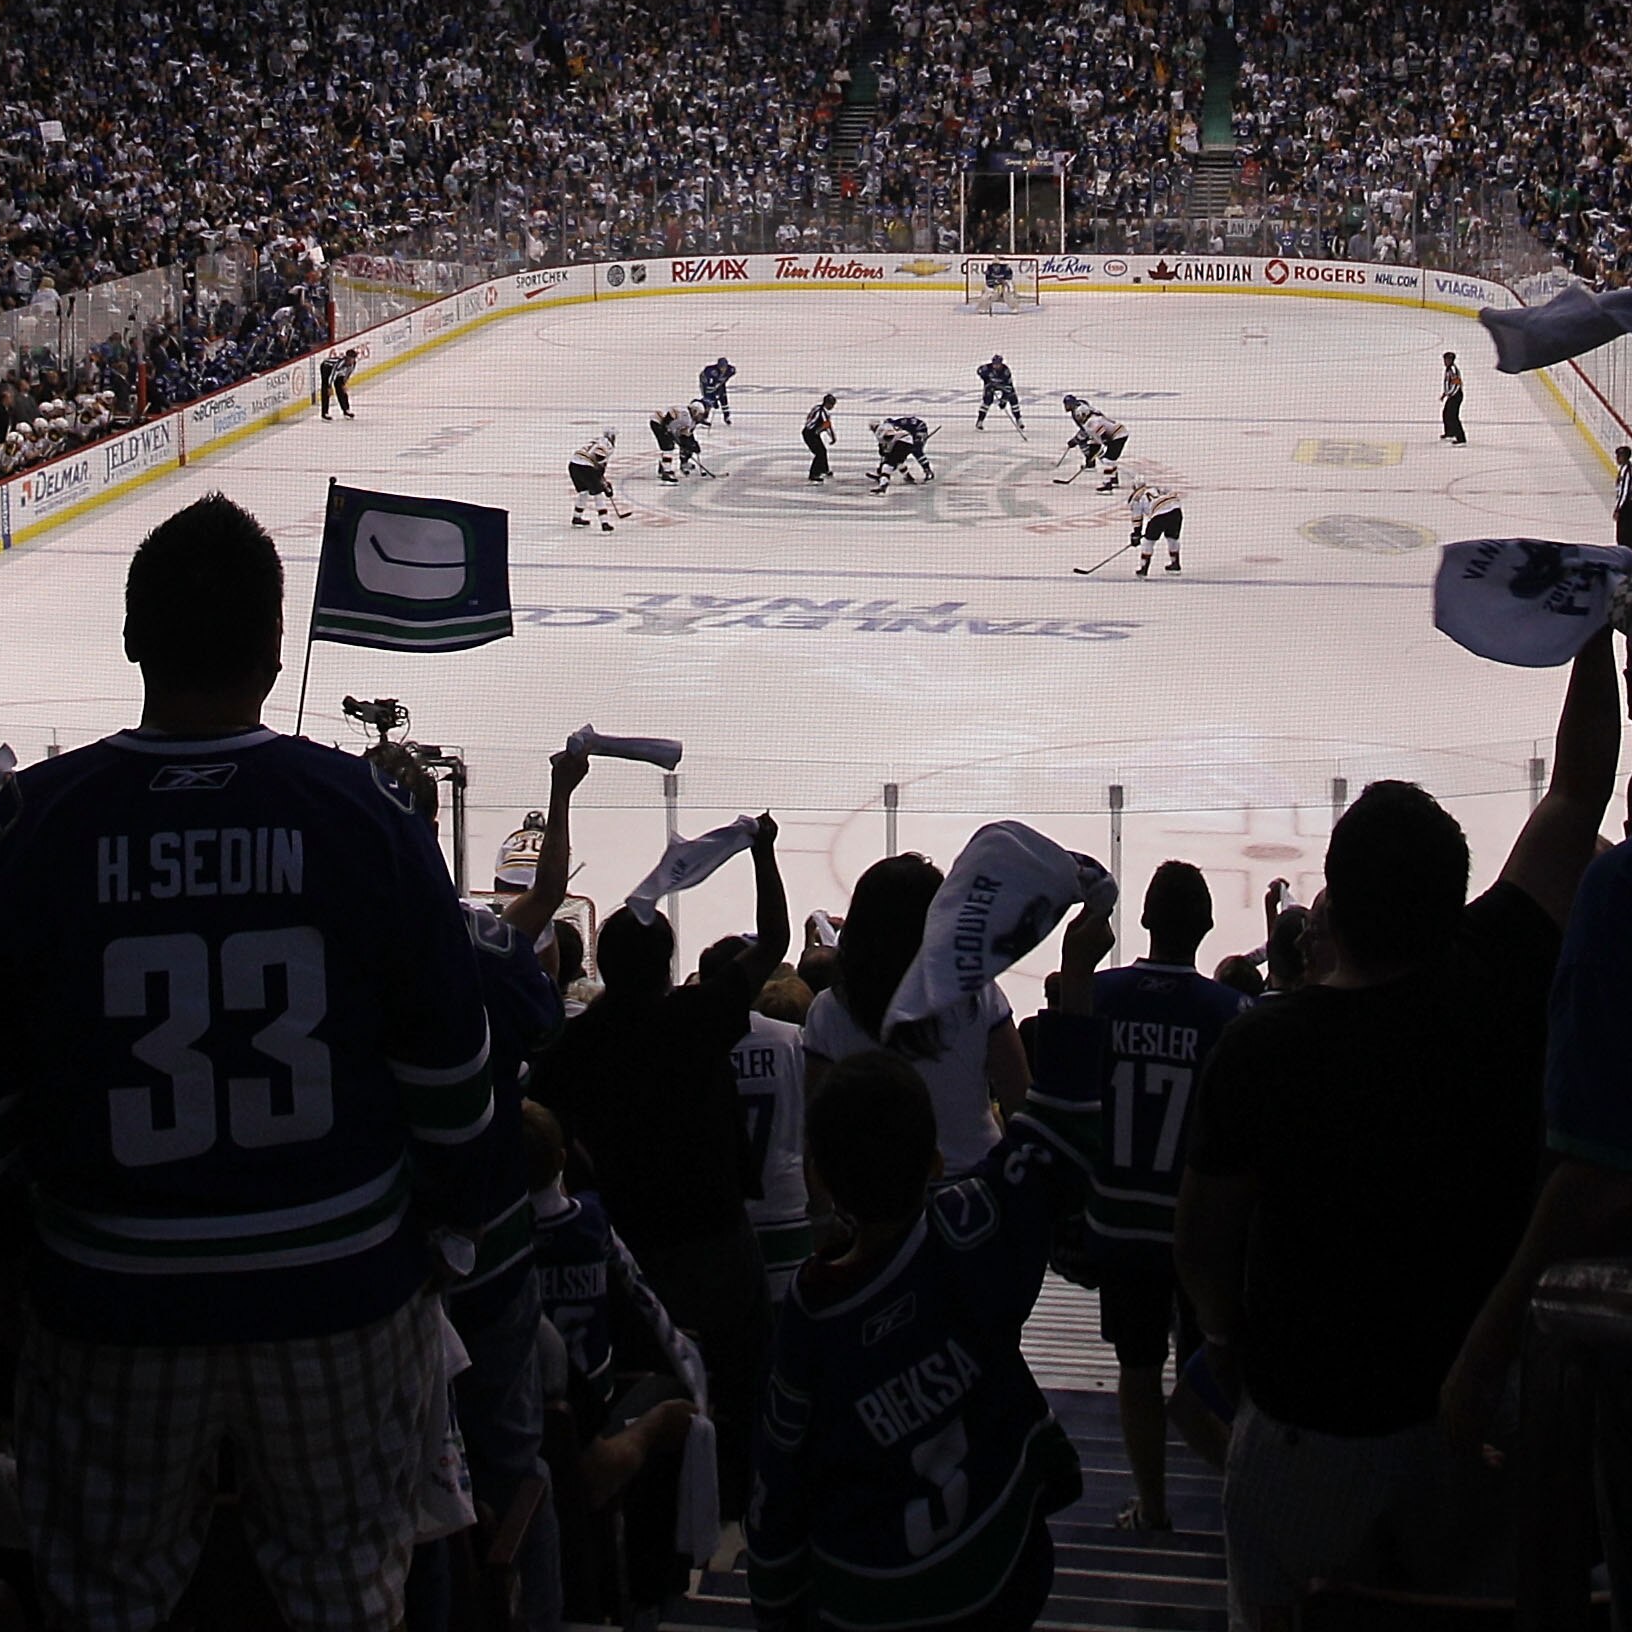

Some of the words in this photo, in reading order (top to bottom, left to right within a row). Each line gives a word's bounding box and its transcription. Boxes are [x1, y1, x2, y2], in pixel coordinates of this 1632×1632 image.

[671, 258, 750, 283] RE/MAX
[774, 256, 810, 280] Tim
[812, 256, 884, 280] Hortons
[1067, 256, 1094, 274] Run
[1173, 261, 1252, 282] CANADIAN
[1293, 265, 1366, 284] ROGERS
[1374, 271, 1418, 288] NHL.COM
[35, 460, 89, 502] DELMAR
[97, 826, 305, 904] H.SEDIN
[102, 924, 335, 1169] 33
[1111, 1019, 1200, 1063] KESLER
[1110, 1059, 1193, 1173] 17
[852, 1335, 985, 1450] BIEKSA
